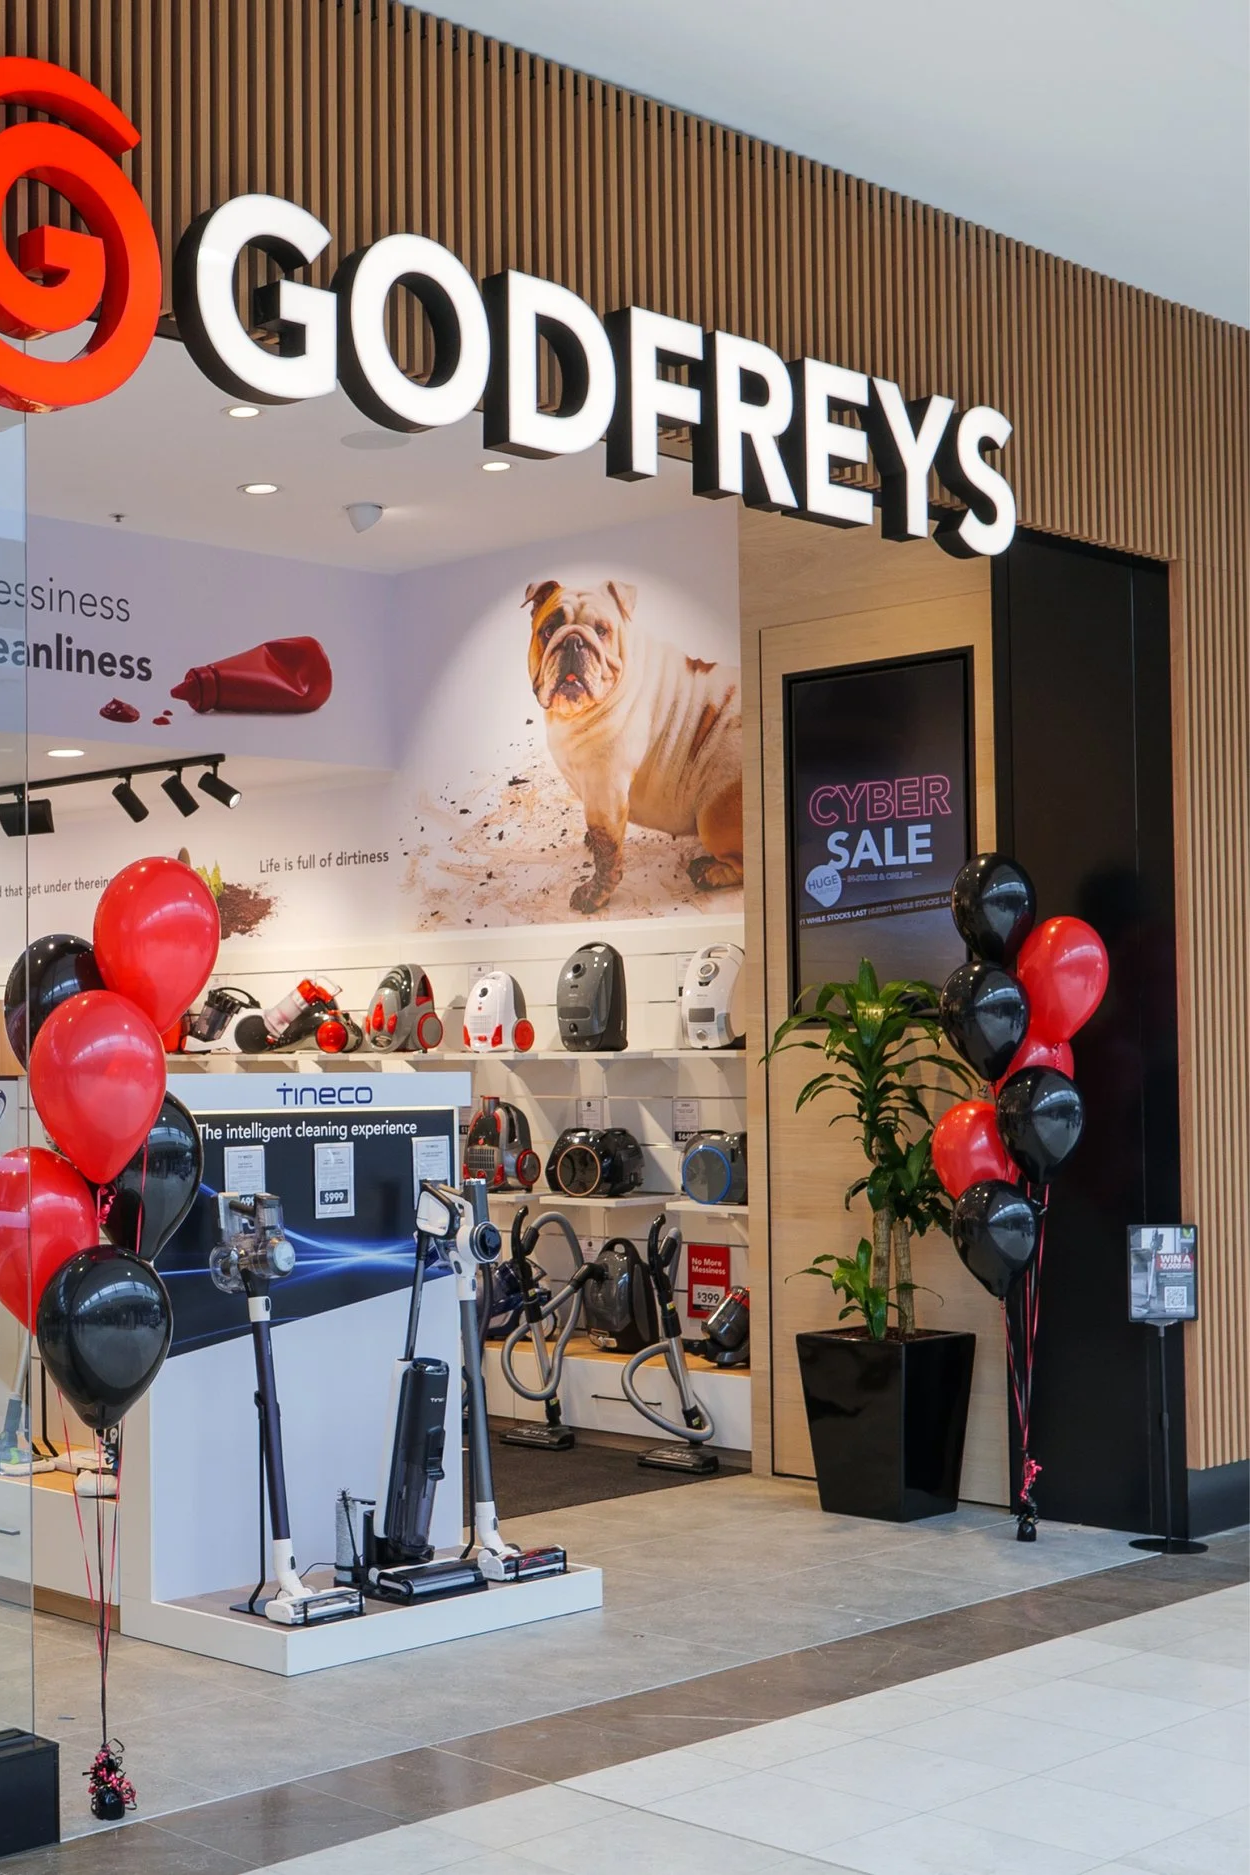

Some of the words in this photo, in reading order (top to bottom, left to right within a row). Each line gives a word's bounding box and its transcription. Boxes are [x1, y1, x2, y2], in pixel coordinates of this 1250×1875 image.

[180, 193, 1016, 560] GODFREYS
[808, 774, 952, 827] CYBER
[826, 823, 933, 871] SALE
[259, 857, 281, 873] Life
[284, 857, 294, 871] is
[297, 854, 316, 870] full
[319, 852, 332, 868] of
[336, 850, 389, 867] dirtiness
[4, 885, 23, 898] that
[26, 884, 42, 898] get
[44, 881, 72, 894] under
[807, 874, 839, 892] HUGE
[827, 911, 851, 922] STOCKS
[851, 908, 867, 918] LAST
[198, 1123, 223, 1140] The
[226, 1121, 292, 1142] intelligent
[295, 1120, 348, 1140] cleaning
[351, 1119, 418, 1139] experience
[324, 1191, 345, 1203] $999
[692, 1257, 702, 1265] No
[1160, 1254, 1181, 1263] WIN
[1183, 1254, 1191, 1263] A
[692, 1265, 726, 1275] Messiness
[697, 1291, 719, 1304] $399
